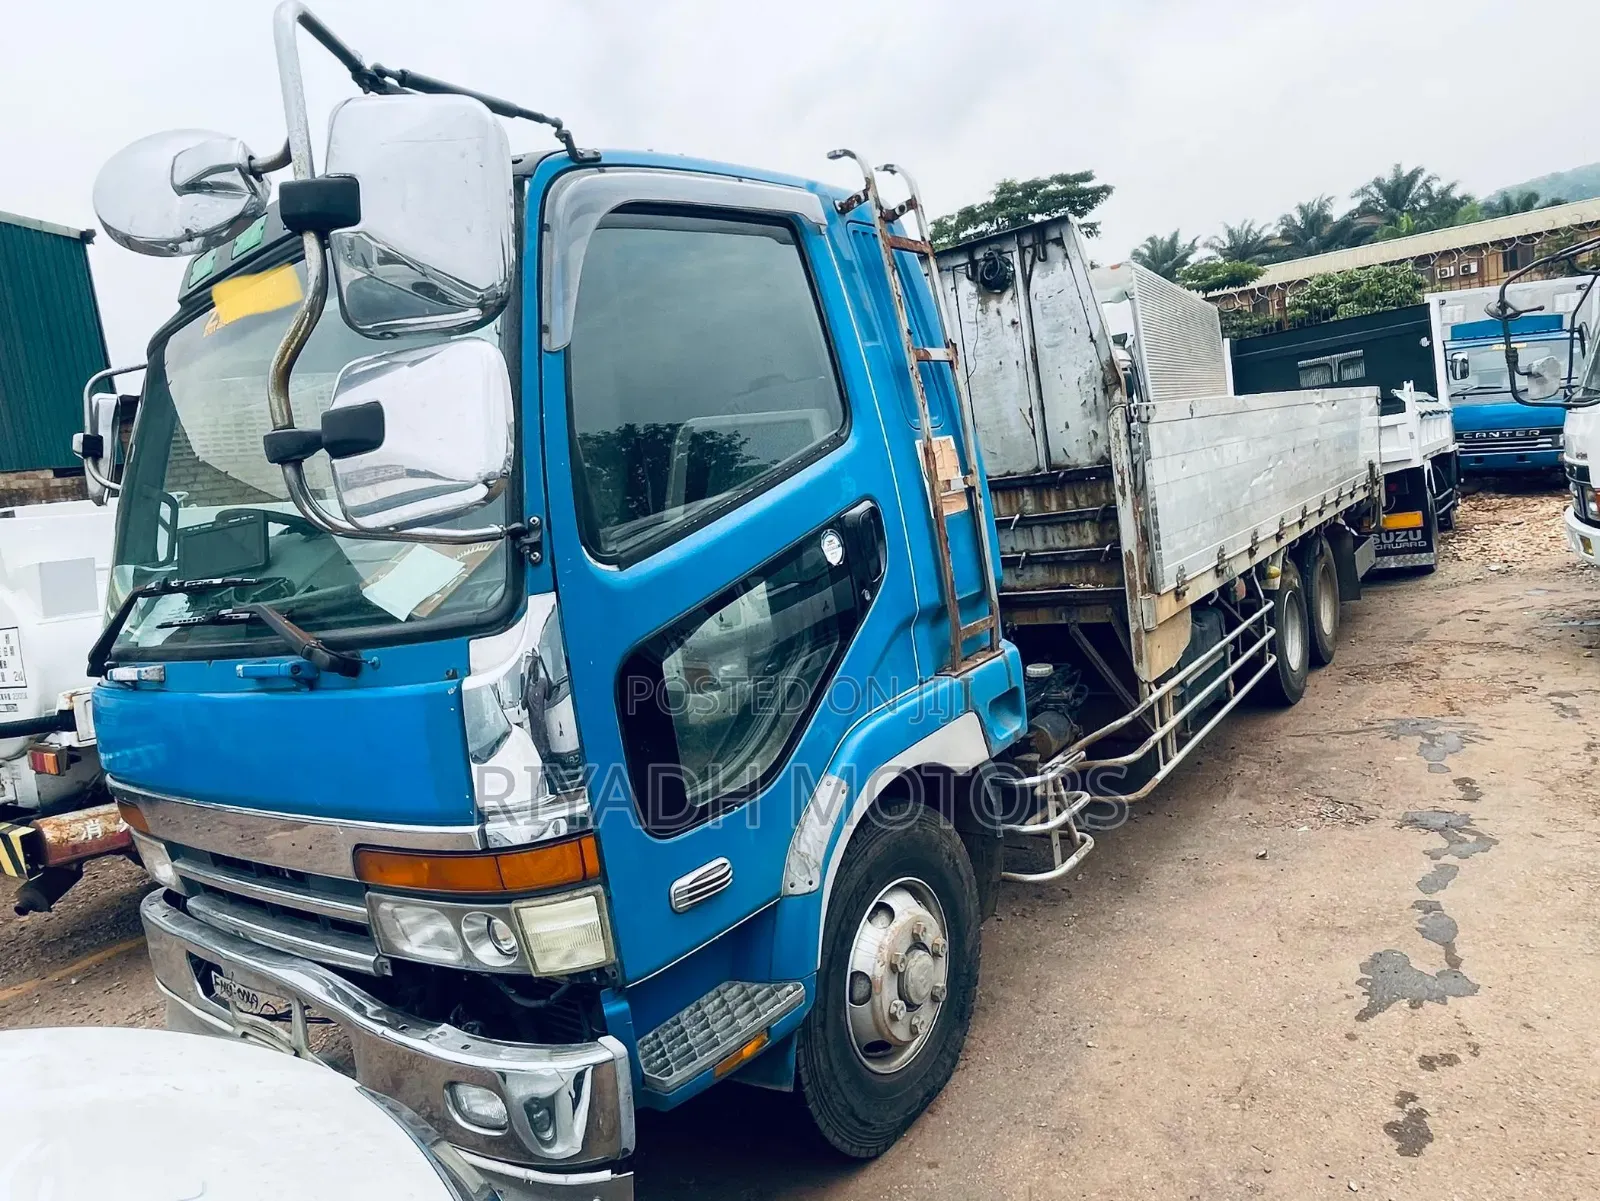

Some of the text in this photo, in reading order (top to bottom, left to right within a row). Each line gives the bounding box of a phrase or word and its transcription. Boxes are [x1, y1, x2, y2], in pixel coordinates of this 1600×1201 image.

[1463, 430, 1541, 439] CANTER
[1372, 529, 1422, 545] SUZU
[1375, 540, 1427, 551] ORWARD
